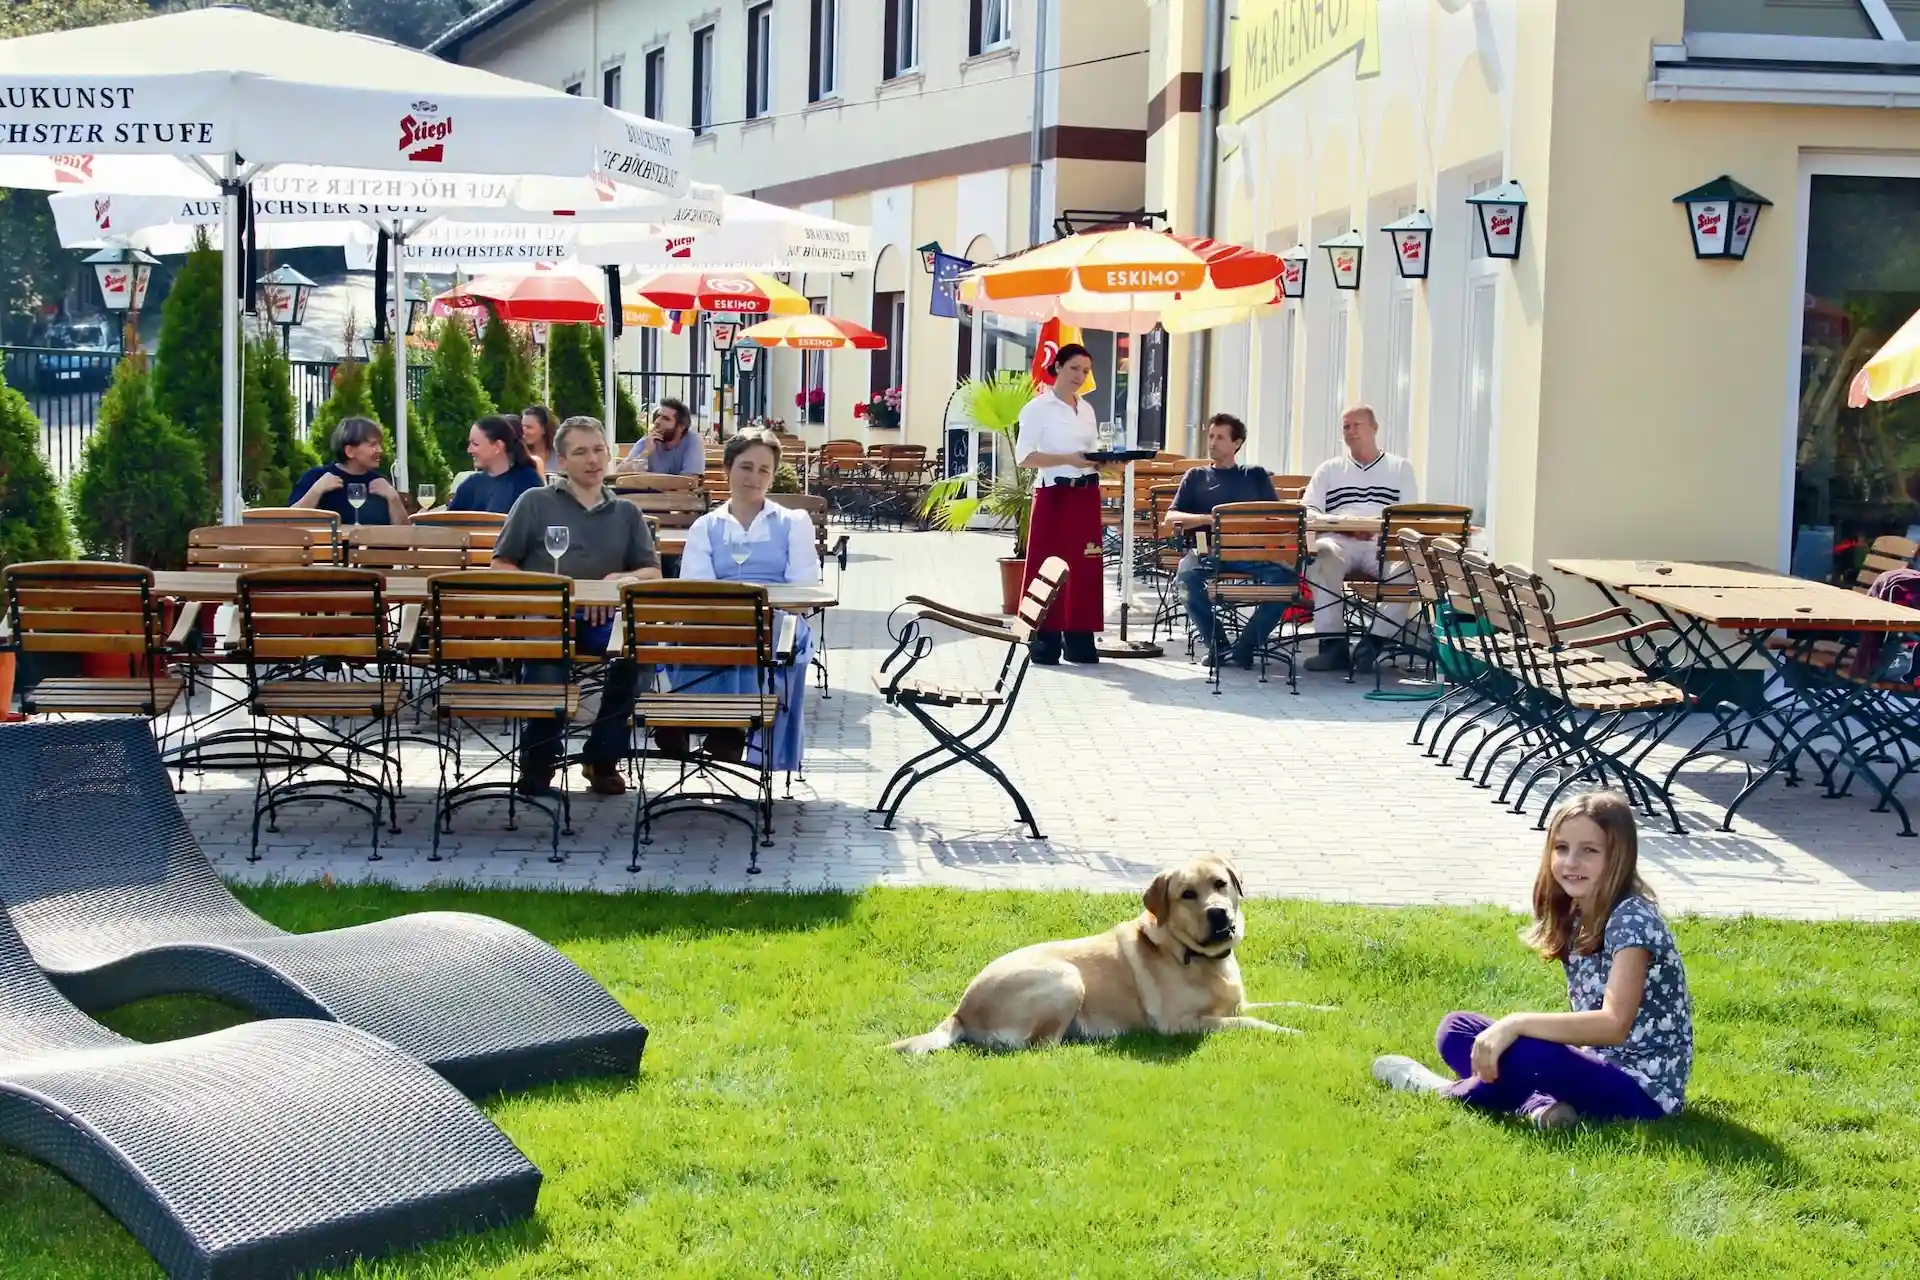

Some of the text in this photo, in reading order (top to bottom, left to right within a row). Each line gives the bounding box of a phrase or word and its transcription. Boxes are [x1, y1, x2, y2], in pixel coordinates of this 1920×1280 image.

[0, 123, 213, 143] HSTER STUFE
[399, 114, 453, 151] Stiegl
[181, 202, 221, 216] AUF
[518, 245, 565, 257] STUFE
[1106, 270, 1179, 287] ESKIMO
[714, 299, 756, 311] ESKIMO
[798, 338, 833, 347] ESKIMO
